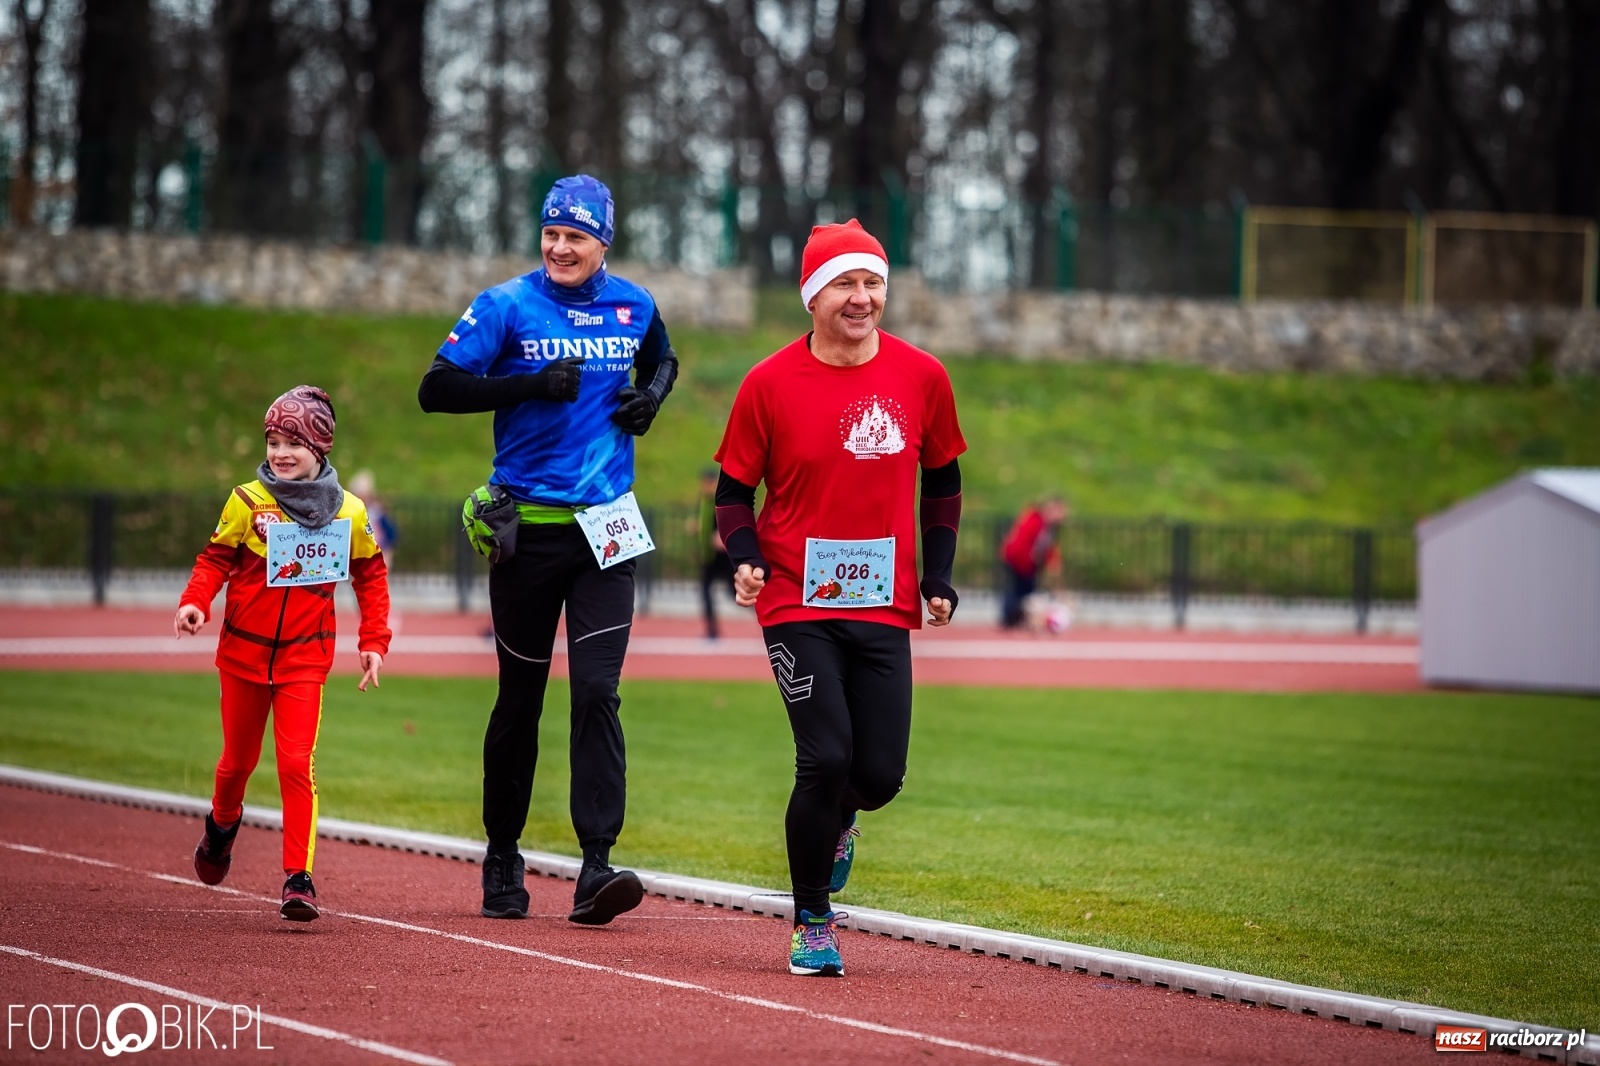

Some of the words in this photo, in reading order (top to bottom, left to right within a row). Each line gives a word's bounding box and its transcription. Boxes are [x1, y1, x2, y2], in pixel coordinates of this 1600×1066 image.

[606, 517, 629, 537] 058
[295, 542, 327, 559] 056
[835, 563, 870, 580] 026
